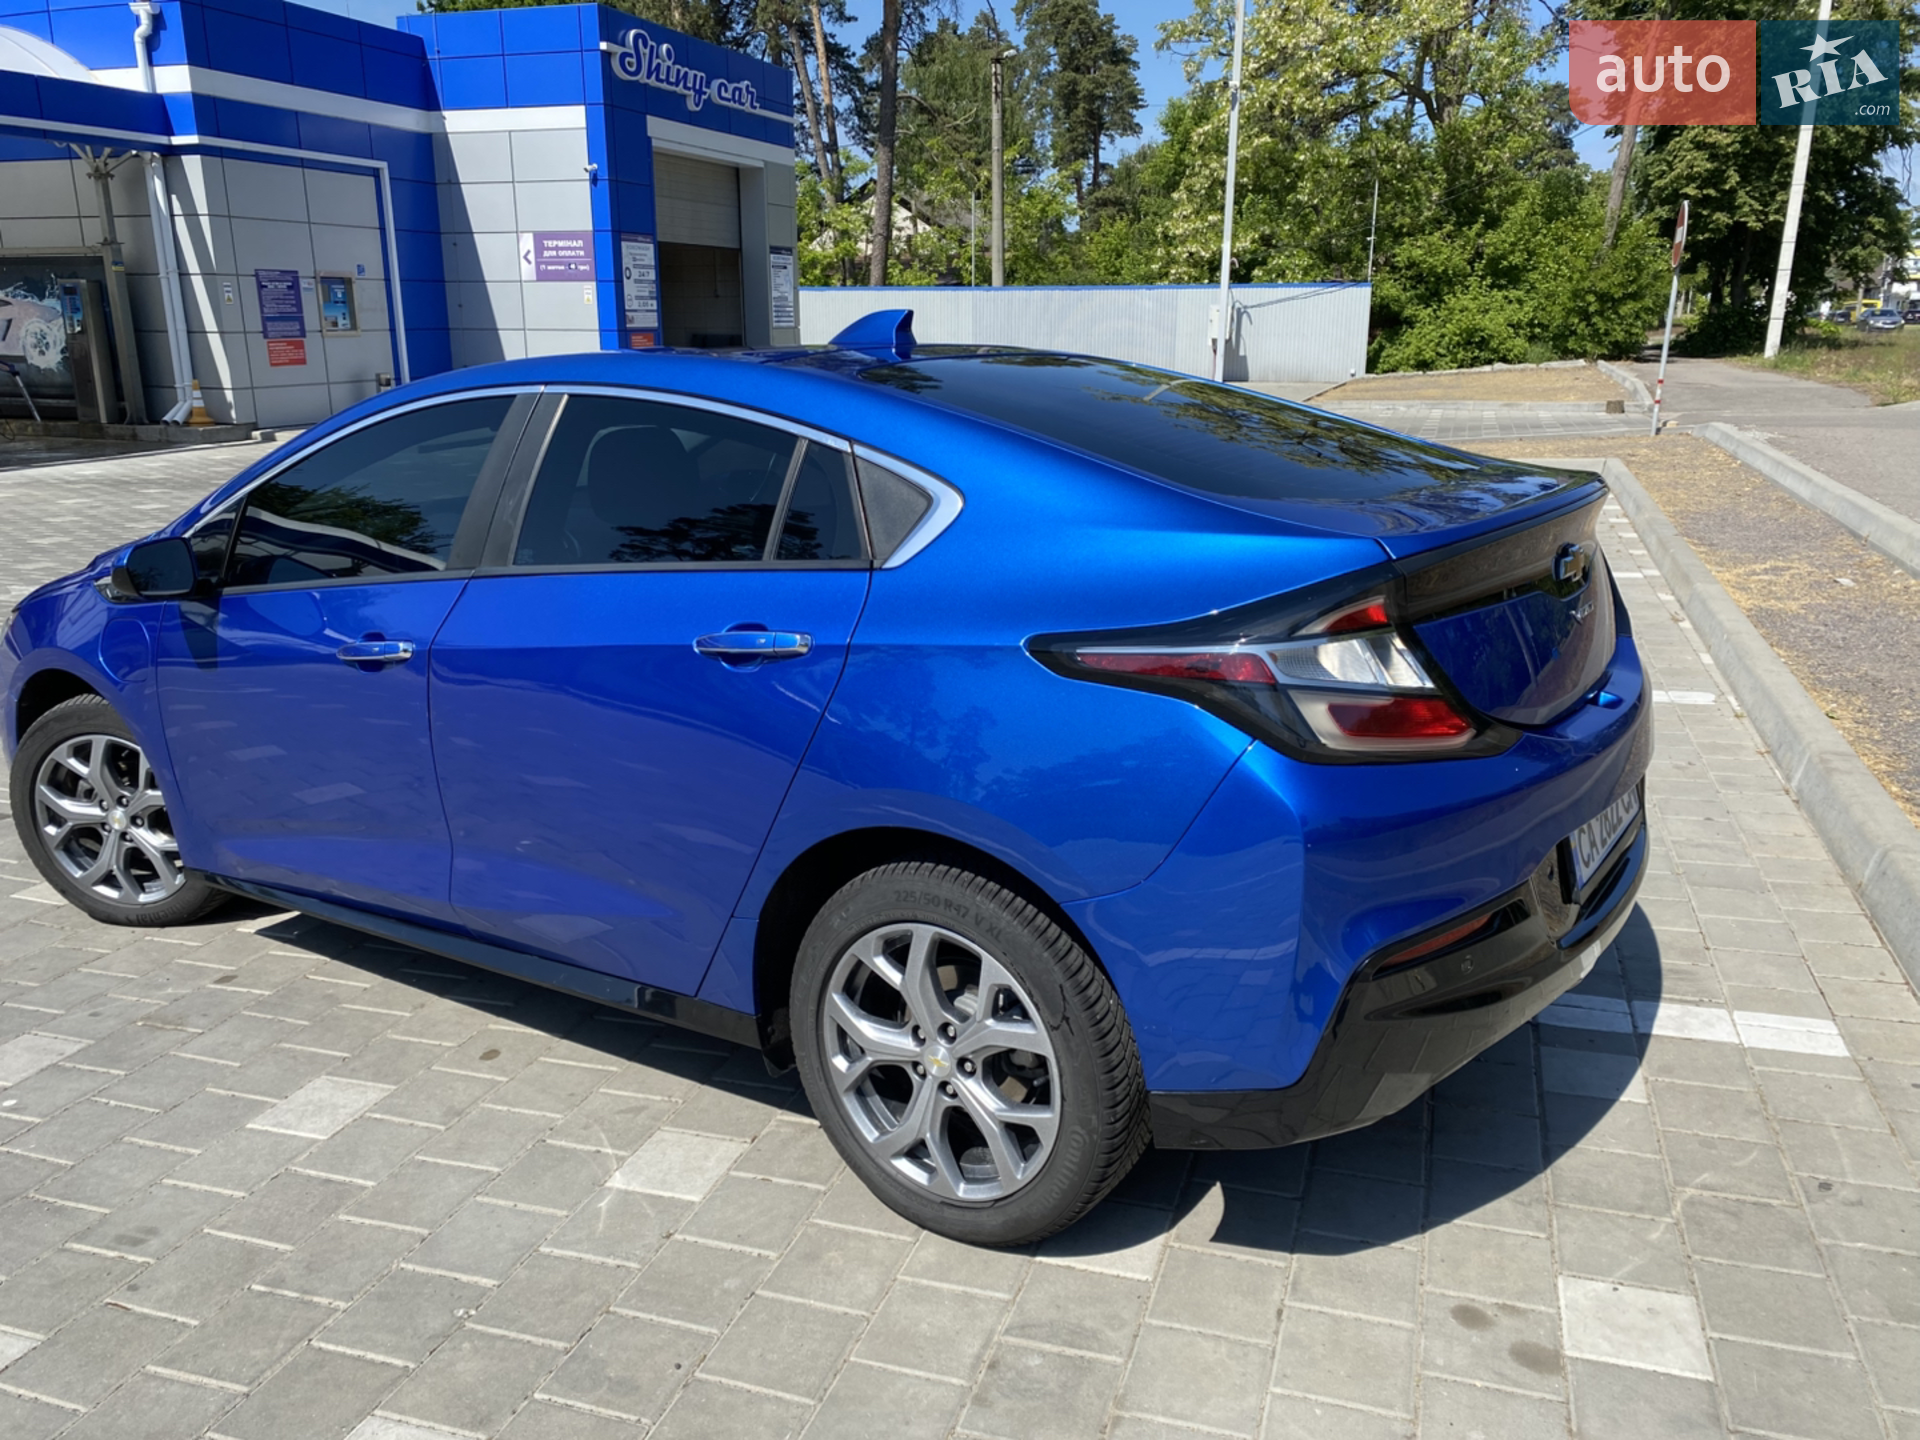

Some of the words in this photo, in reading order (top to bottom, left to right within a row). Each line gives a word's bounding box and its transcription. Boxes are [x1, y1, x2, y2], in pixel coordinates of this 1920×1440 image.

[612, 29, 711, 111] Shiny
[711, 78, 760, 111] car
[543, 239, 584, 248] ТЕРМІНАЛ
[1577, 823, 1600, 869] CA
[894, 890, 941, 908] 225/50
[985, 921, 1003, 945] XL
